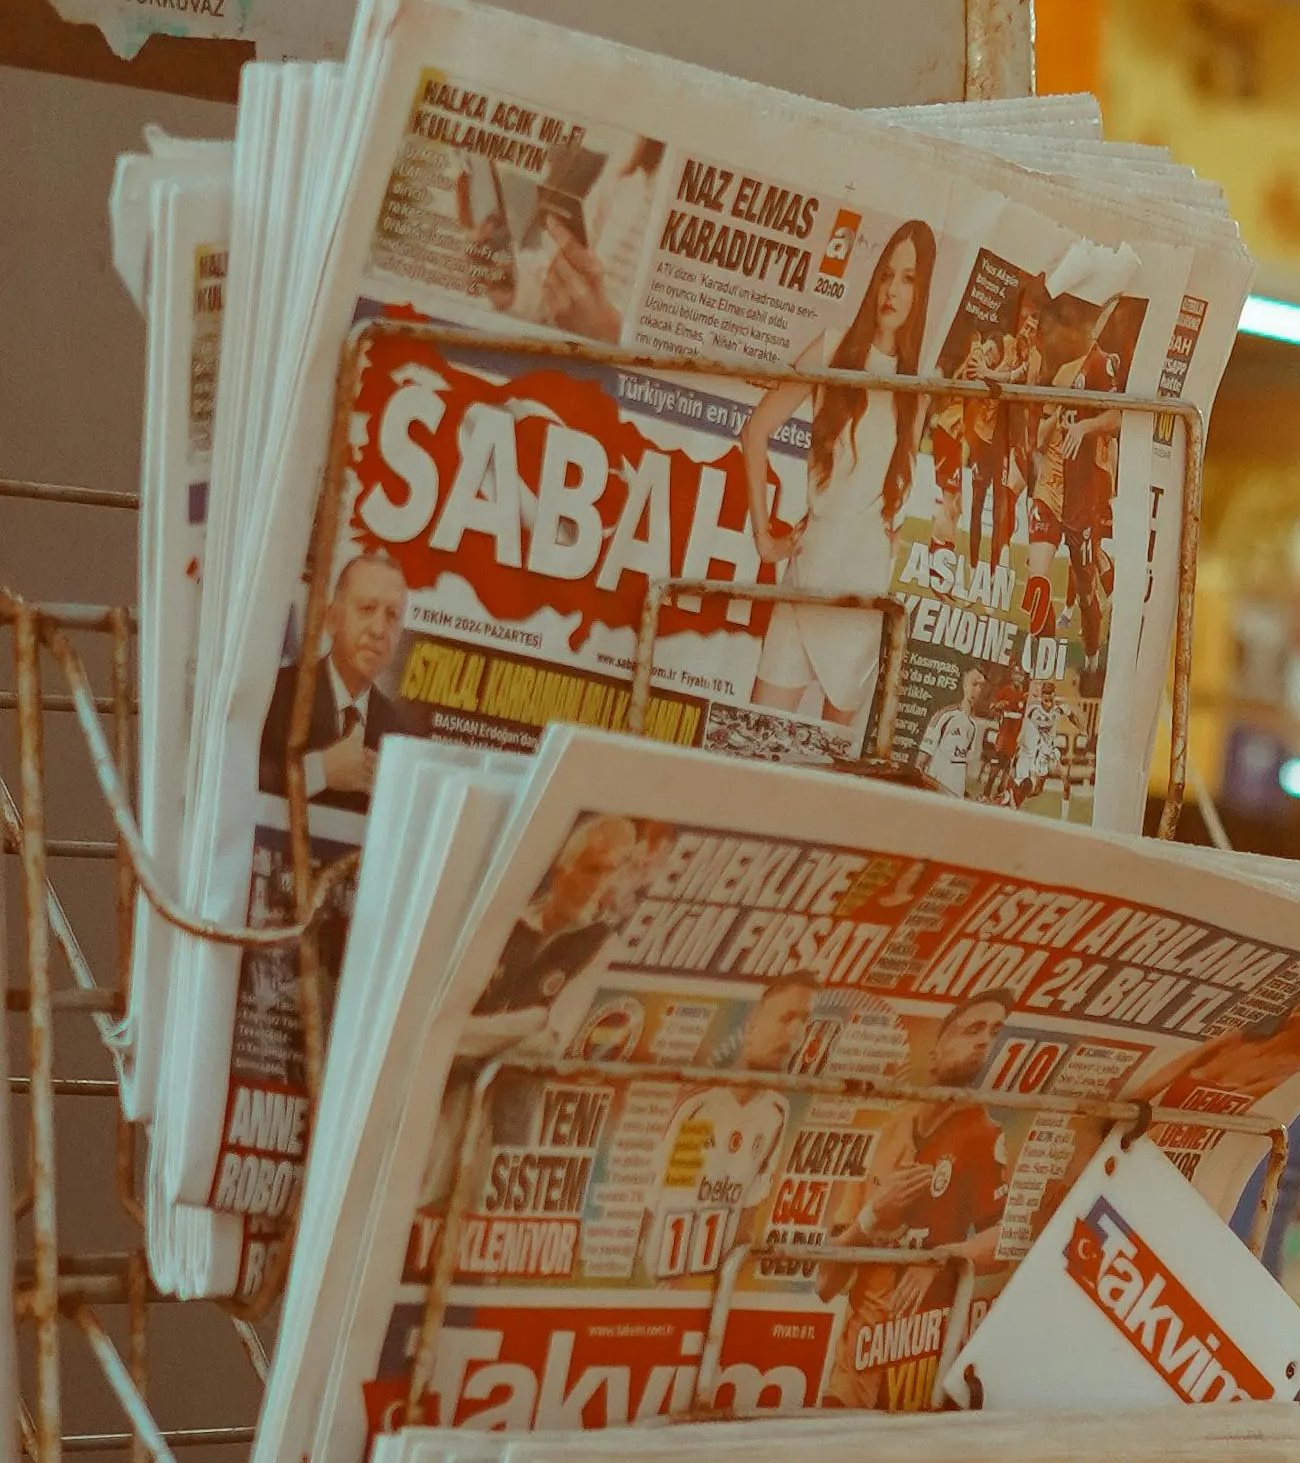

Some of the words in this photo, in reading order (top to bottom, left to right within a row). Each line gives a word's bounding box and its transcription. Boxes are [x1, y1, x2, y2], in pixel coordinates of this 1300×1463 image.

[676, 158, 736, 214] NAZ
[731, 177, 819, 239] ELMAS
[659, 209, 812, 293] KARADUT'TA
[813, 276, 846, 300] 20:00
[617, 373, 704, 425] Türkiye'nin
[706, 404, 729, 426] en
[357, 363, 777, 626] SABAH
[899, 541, 1016, 613] ASLAN
[657, 831, 866, 918] EMEKLİYE
[964, 883, 1094, 943] İŞTEN
[1079, 907, 1290, 995] AYRILANA
[622, 900, 738, 970] EKİM
[722, 910, 892, 988] FIRSATI
[1035, 955, 1107, 1012] 24
[1083, 966, 1191, 1026] BİN
[1162, 985, 1235, 1035] TL
[542, 1087, 611, 1148] YENİ
[788, 1127, 877, 1179] KARTAL
[484, 1149, 594, 1215] SİSTEM
[1096, 1212, 1250, 1403] Takvim
